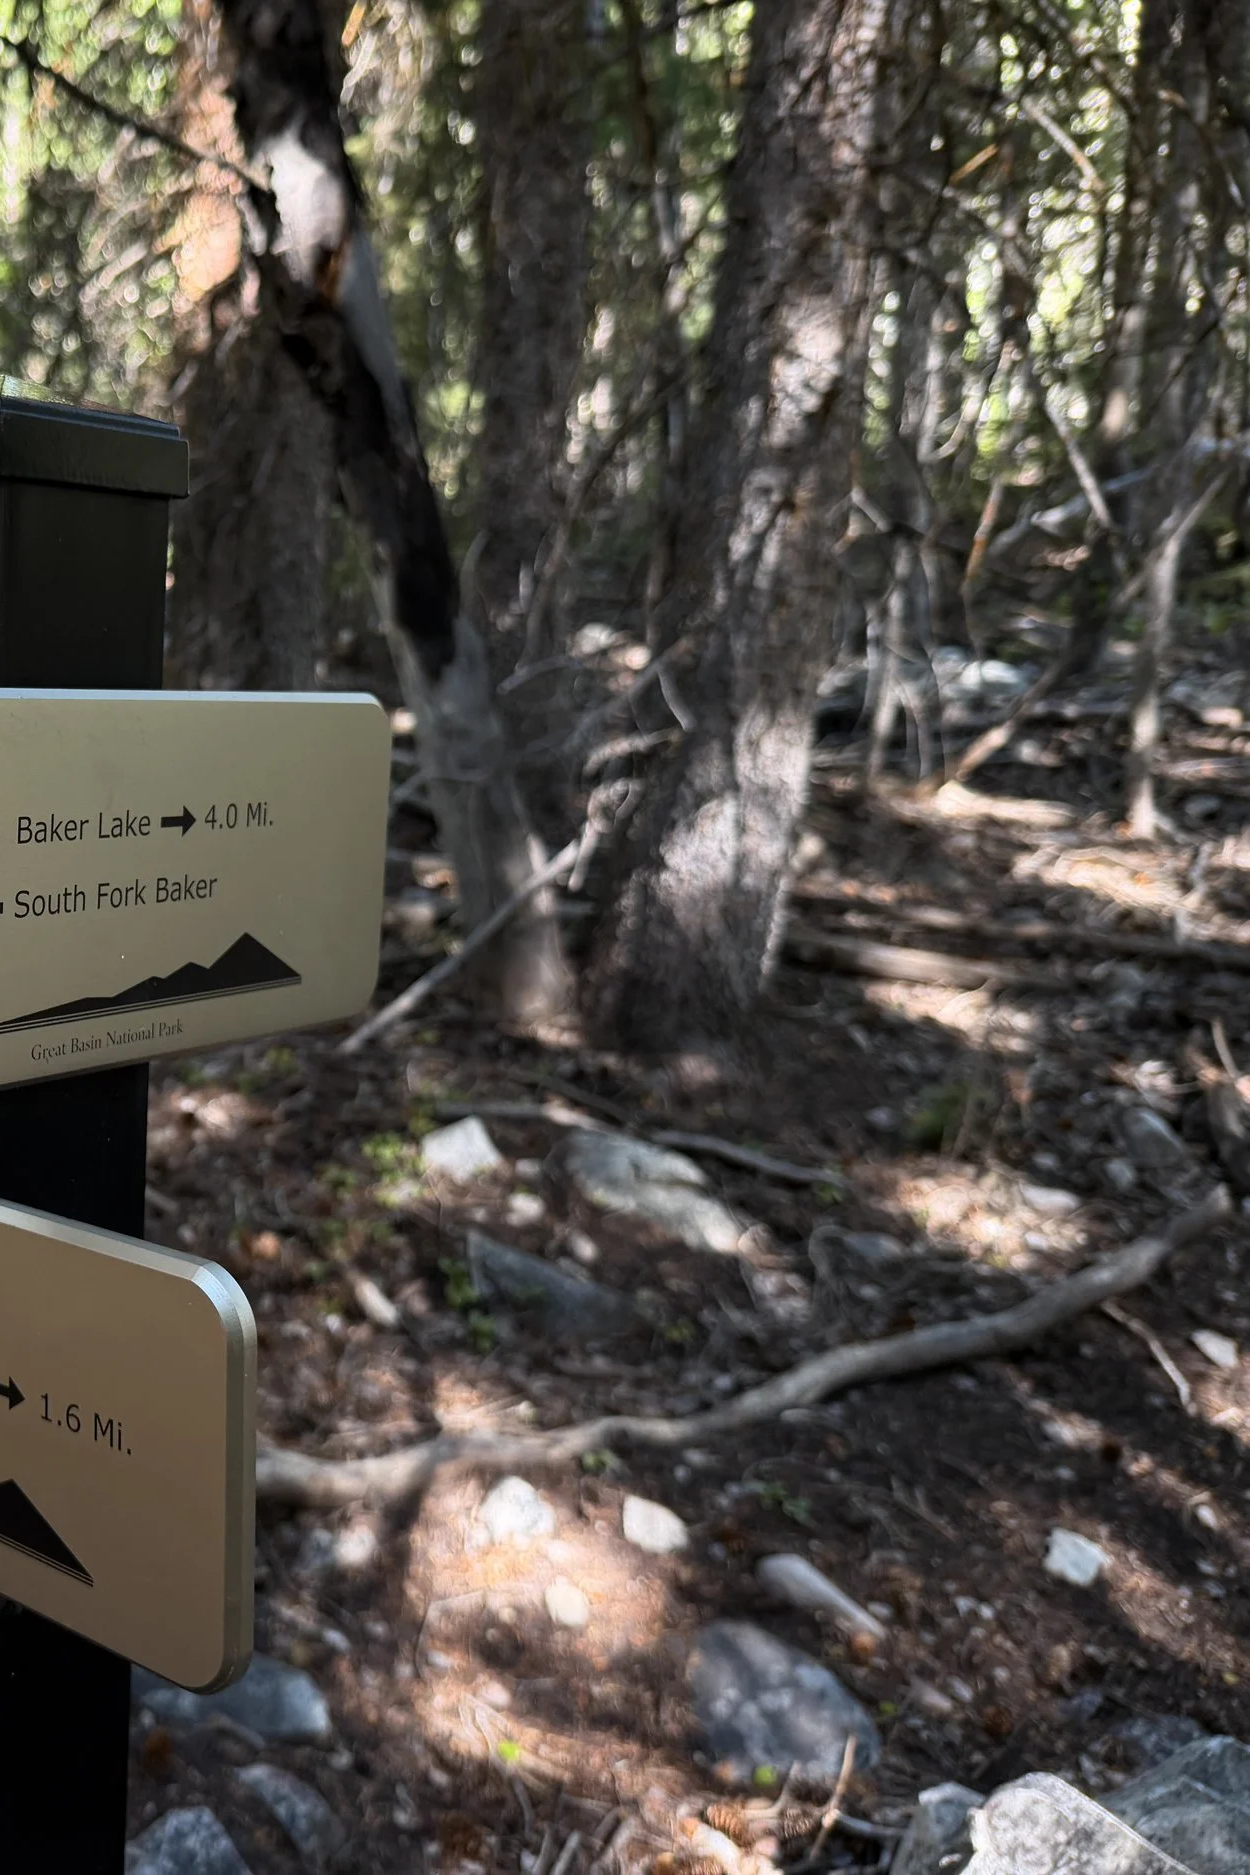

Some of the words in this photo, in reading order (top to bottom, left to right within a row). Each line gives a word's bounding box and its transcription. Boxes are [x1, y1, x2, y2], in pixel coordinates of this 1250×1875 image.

[17, 813, 89, 845] Baker
[98, 809, 151, 840] Lake
[204, 802, 238, 830] 4.0
[246, 801, 274, 827] Mi.
[14, 883, 86, 919] South
[97, 878, 147, 910] Fork
[156, 874, 218, 904] Baker
[30, 1043, 67, 1062] Great
[70, 1035, 102, 1054] Basin
[106, 1022, 155, 1047] National
[158, 1018, 184, 1037] Park
[40, 1392, 82, 1434] 1.6
[93, 1412, 133, 1456] Mi.
